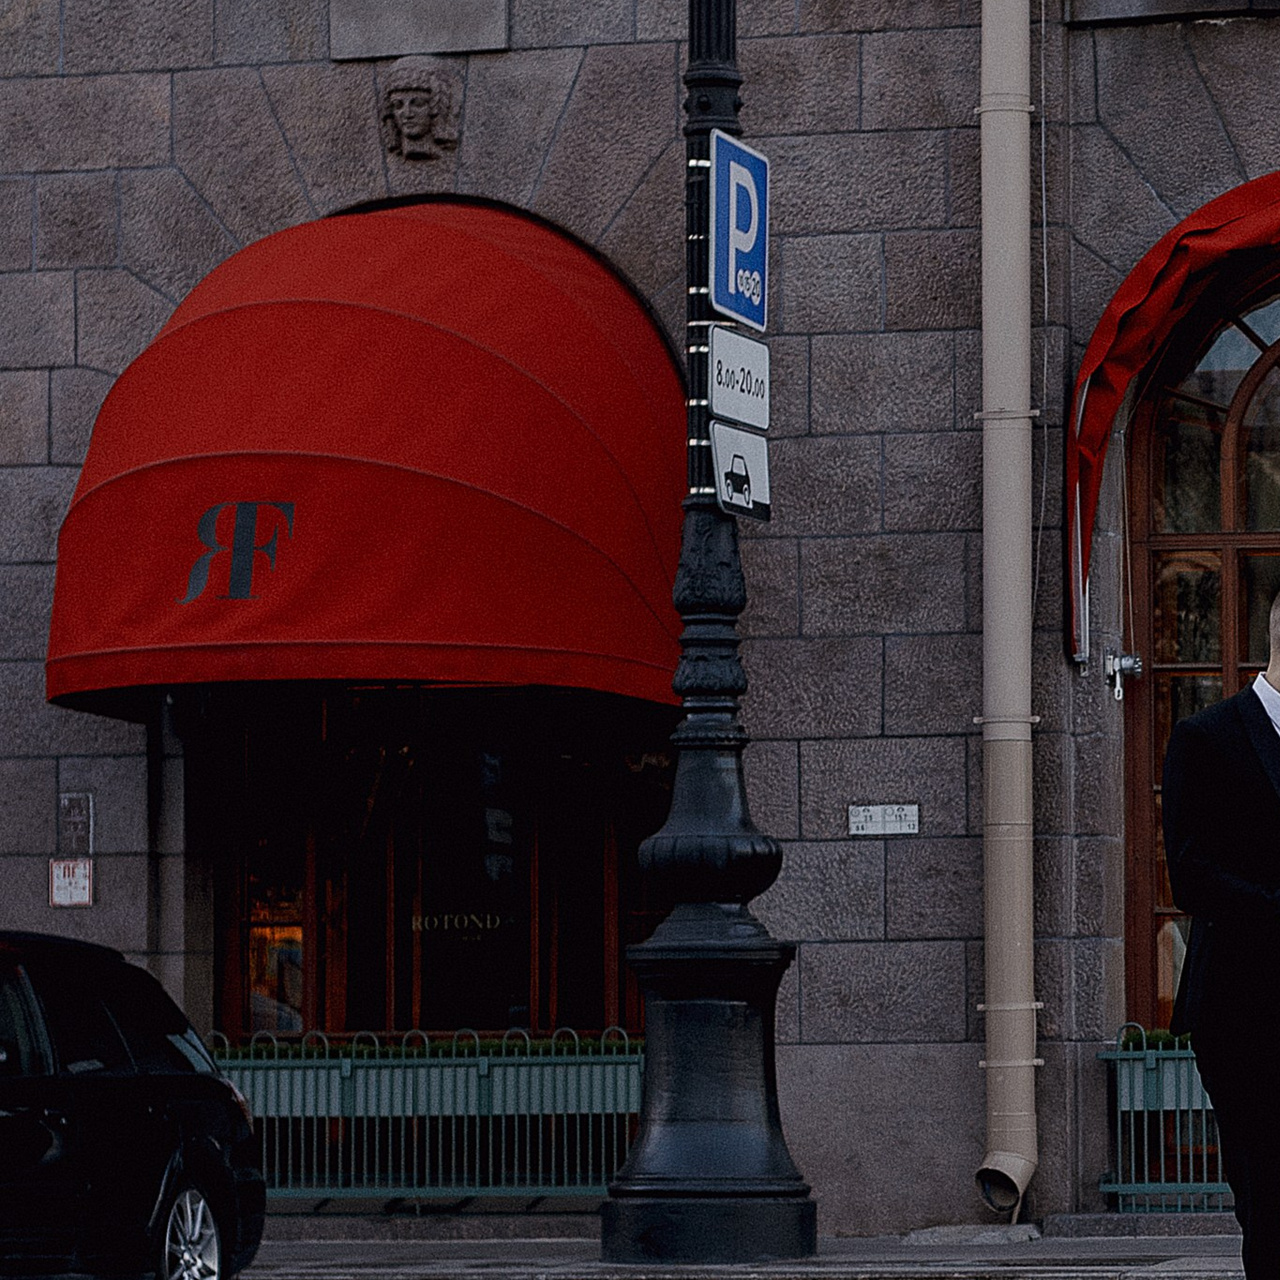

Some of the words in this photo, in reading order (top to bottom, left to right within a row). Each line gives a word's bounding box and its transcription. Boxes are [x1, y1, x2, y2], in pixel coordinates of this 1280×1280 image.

[728, 160, 759, 295] P
[716, 359, 765, 399] 8.00-20.00
[412, 913, 515, 931] ROTOND
